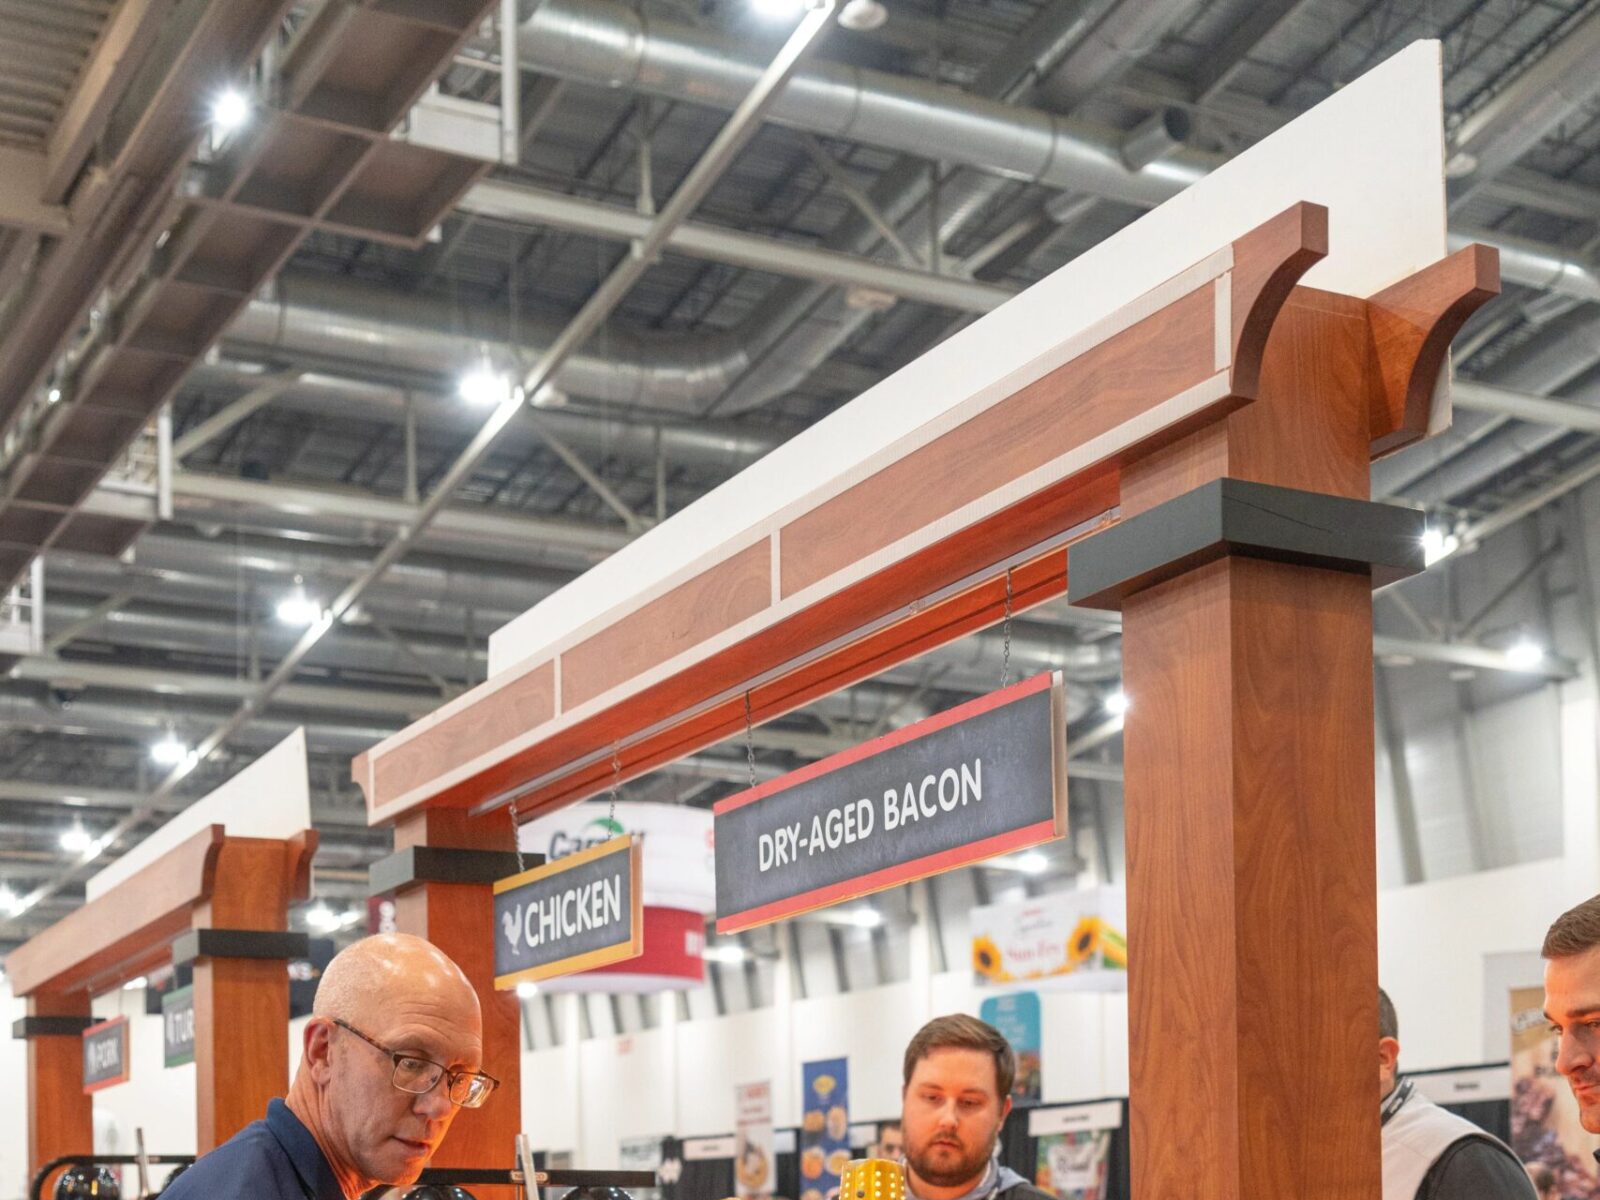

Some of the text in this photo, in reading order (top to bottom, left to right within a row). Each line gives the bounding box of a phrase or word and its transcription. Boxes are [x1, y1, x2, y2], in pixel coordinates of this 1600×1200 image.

[758, 758, 982, 872] DRY-AGED BACON
[524, 874, 621, 948] CHICKEN
